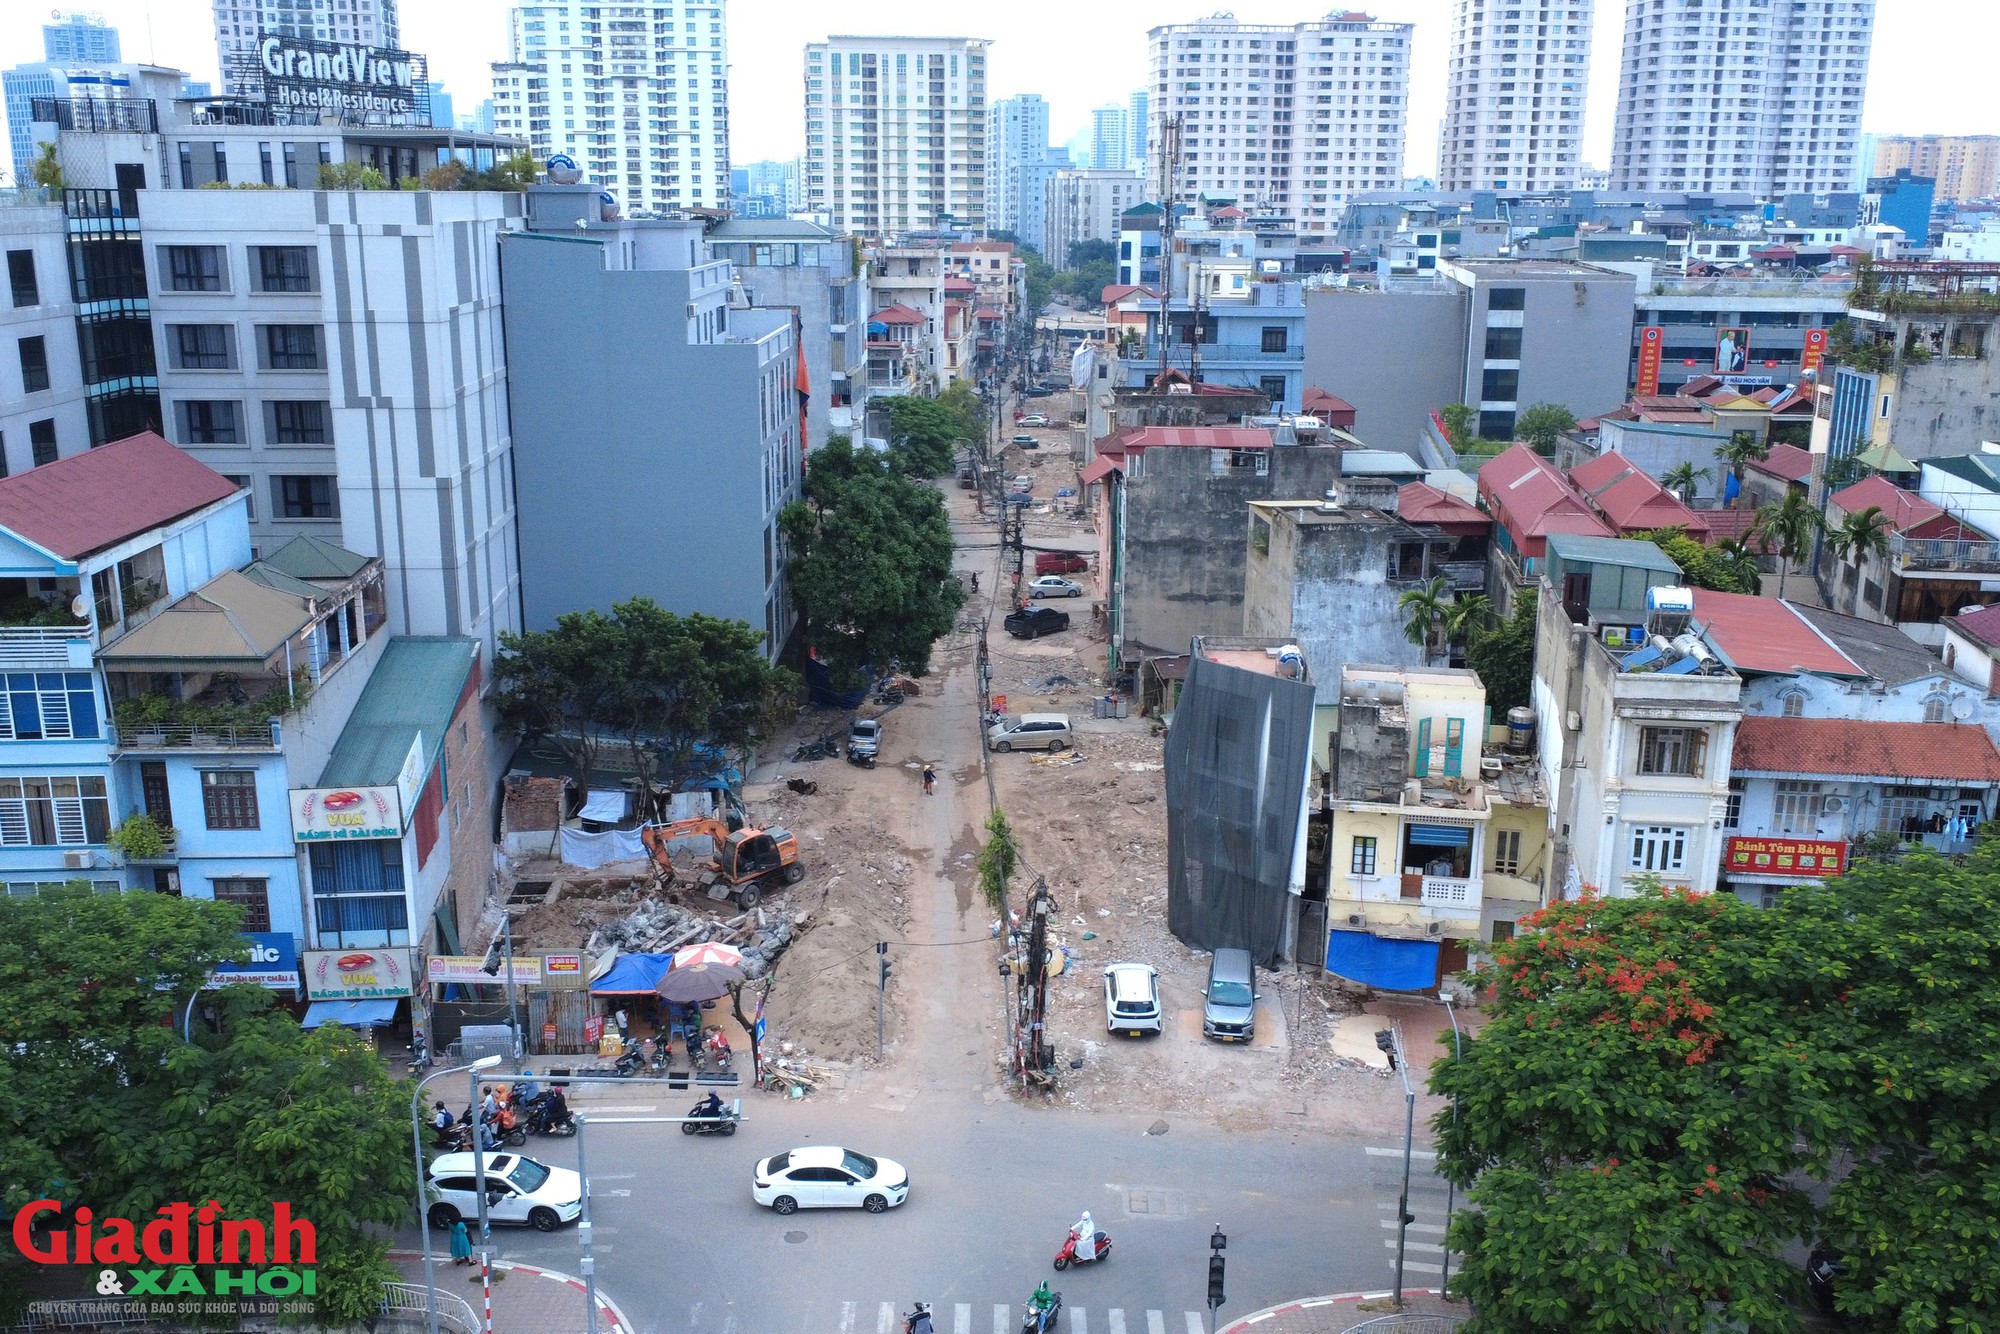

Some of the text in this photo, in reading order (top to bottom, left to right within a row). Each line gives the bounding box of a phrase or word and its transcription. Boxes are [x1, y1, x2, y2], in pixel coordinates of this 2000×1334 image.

[262, 38, 412, 87] GrandView
[278, 85, 407, 112] Hotel&Residence
[327, 813, 365, 826] VUA
[1735, 841, 1766, 852] Bánh
[1768, 842, 1796, 853] Tôm
[1797, 843, 1814, 854] Bà
[341, 973, 377, 986] VUA
